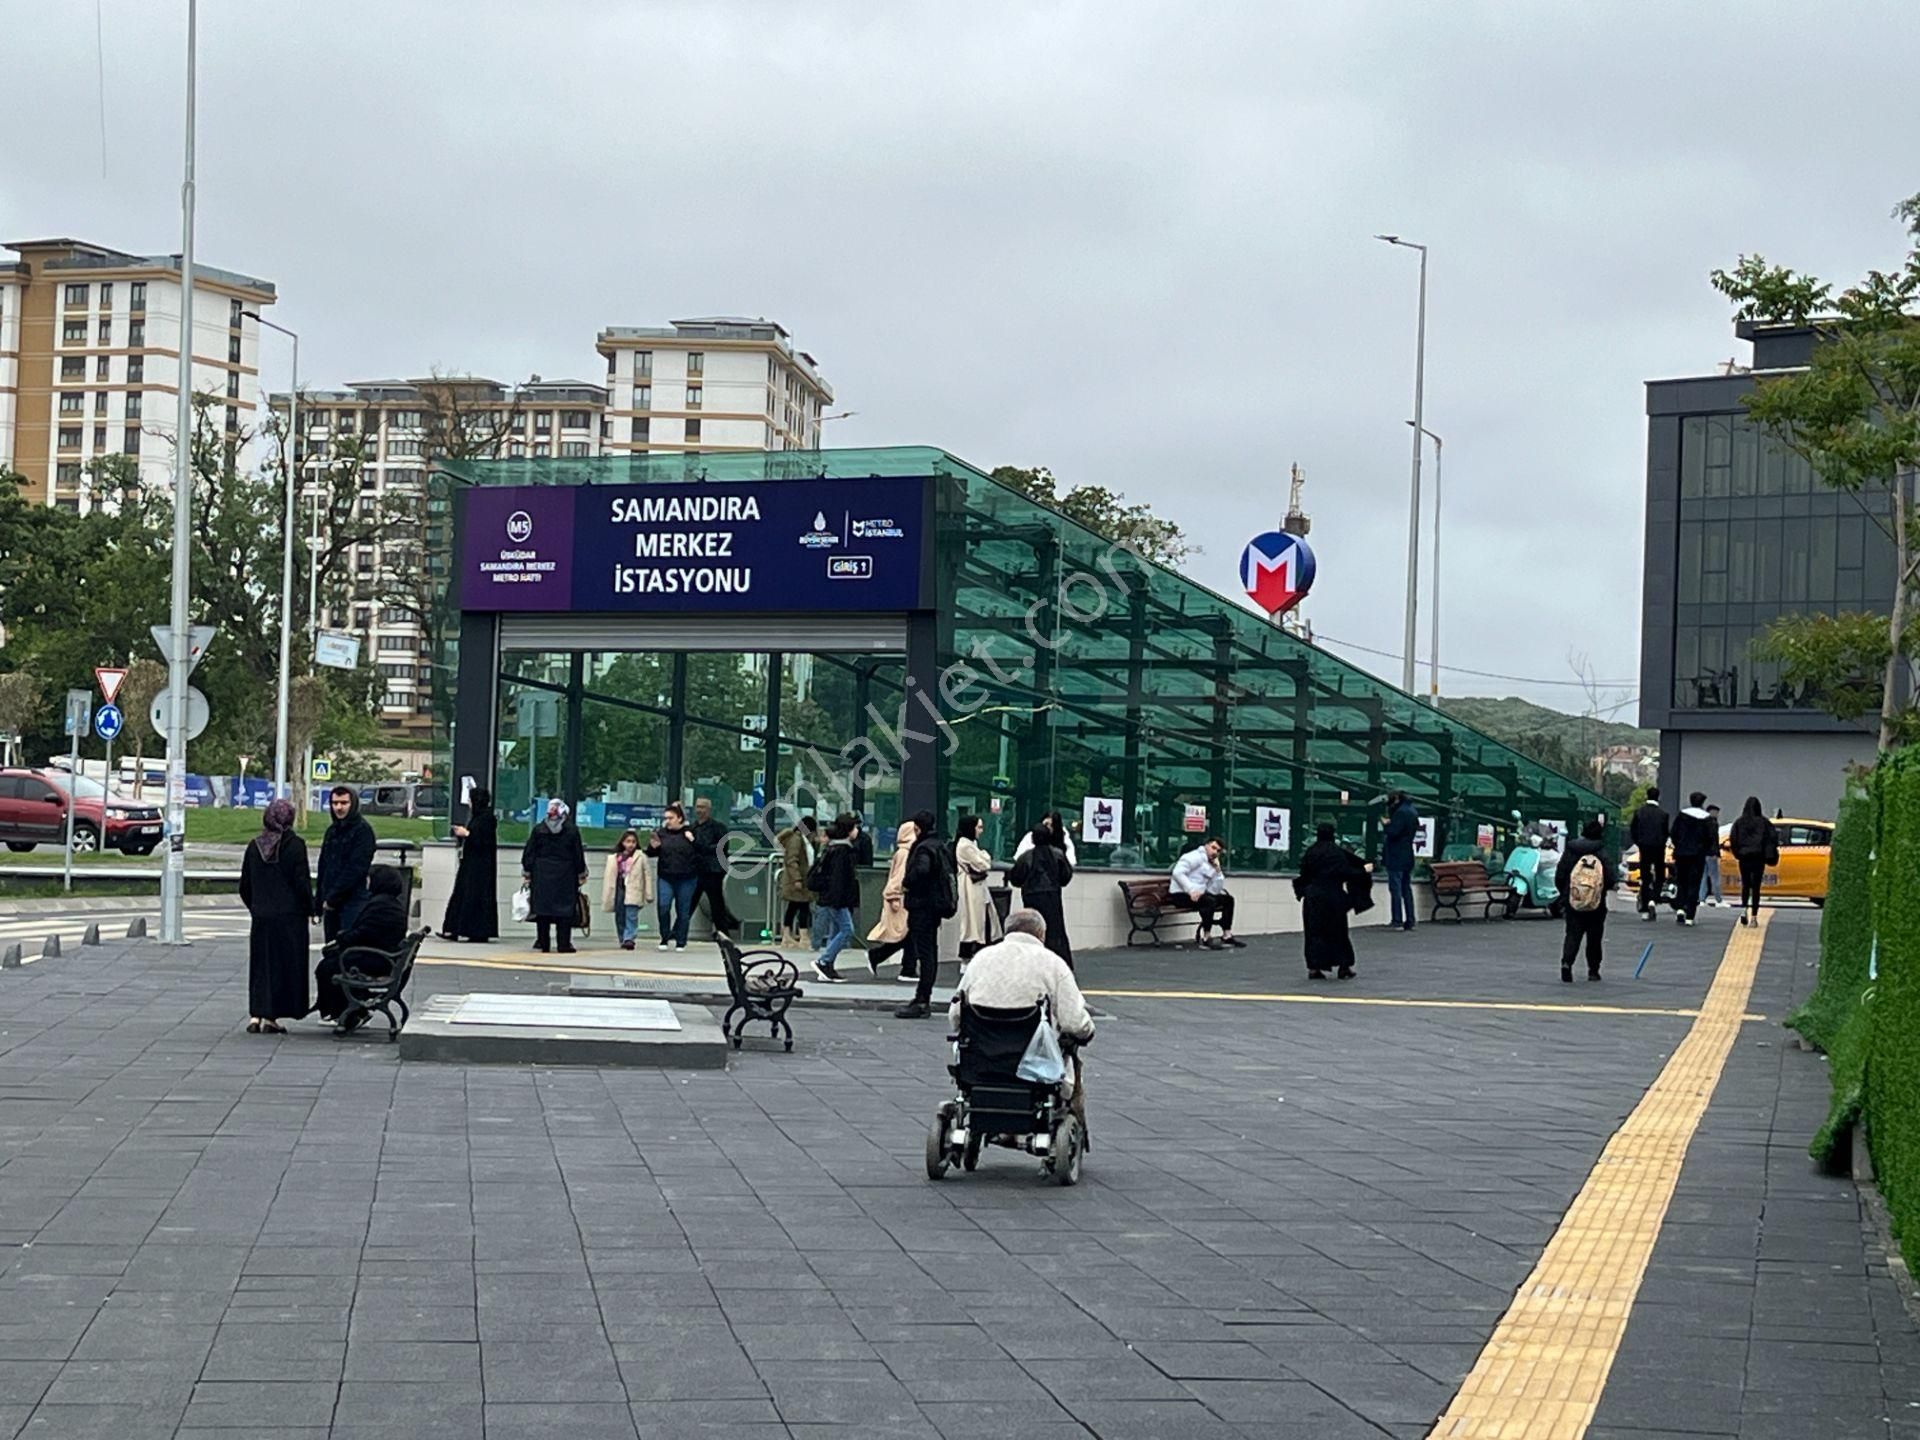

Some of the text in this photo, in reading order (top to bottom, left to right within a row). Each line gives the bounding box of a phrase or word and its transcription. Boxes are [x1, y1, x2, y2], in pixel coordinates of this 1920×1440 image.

[611, 496, 761, 523] SAMANDIRA
[510, 520, 529, 534] M5
[636, 532, 733, 557] MERKEZ
[614, 563, 751, 593] İSTASYONU
